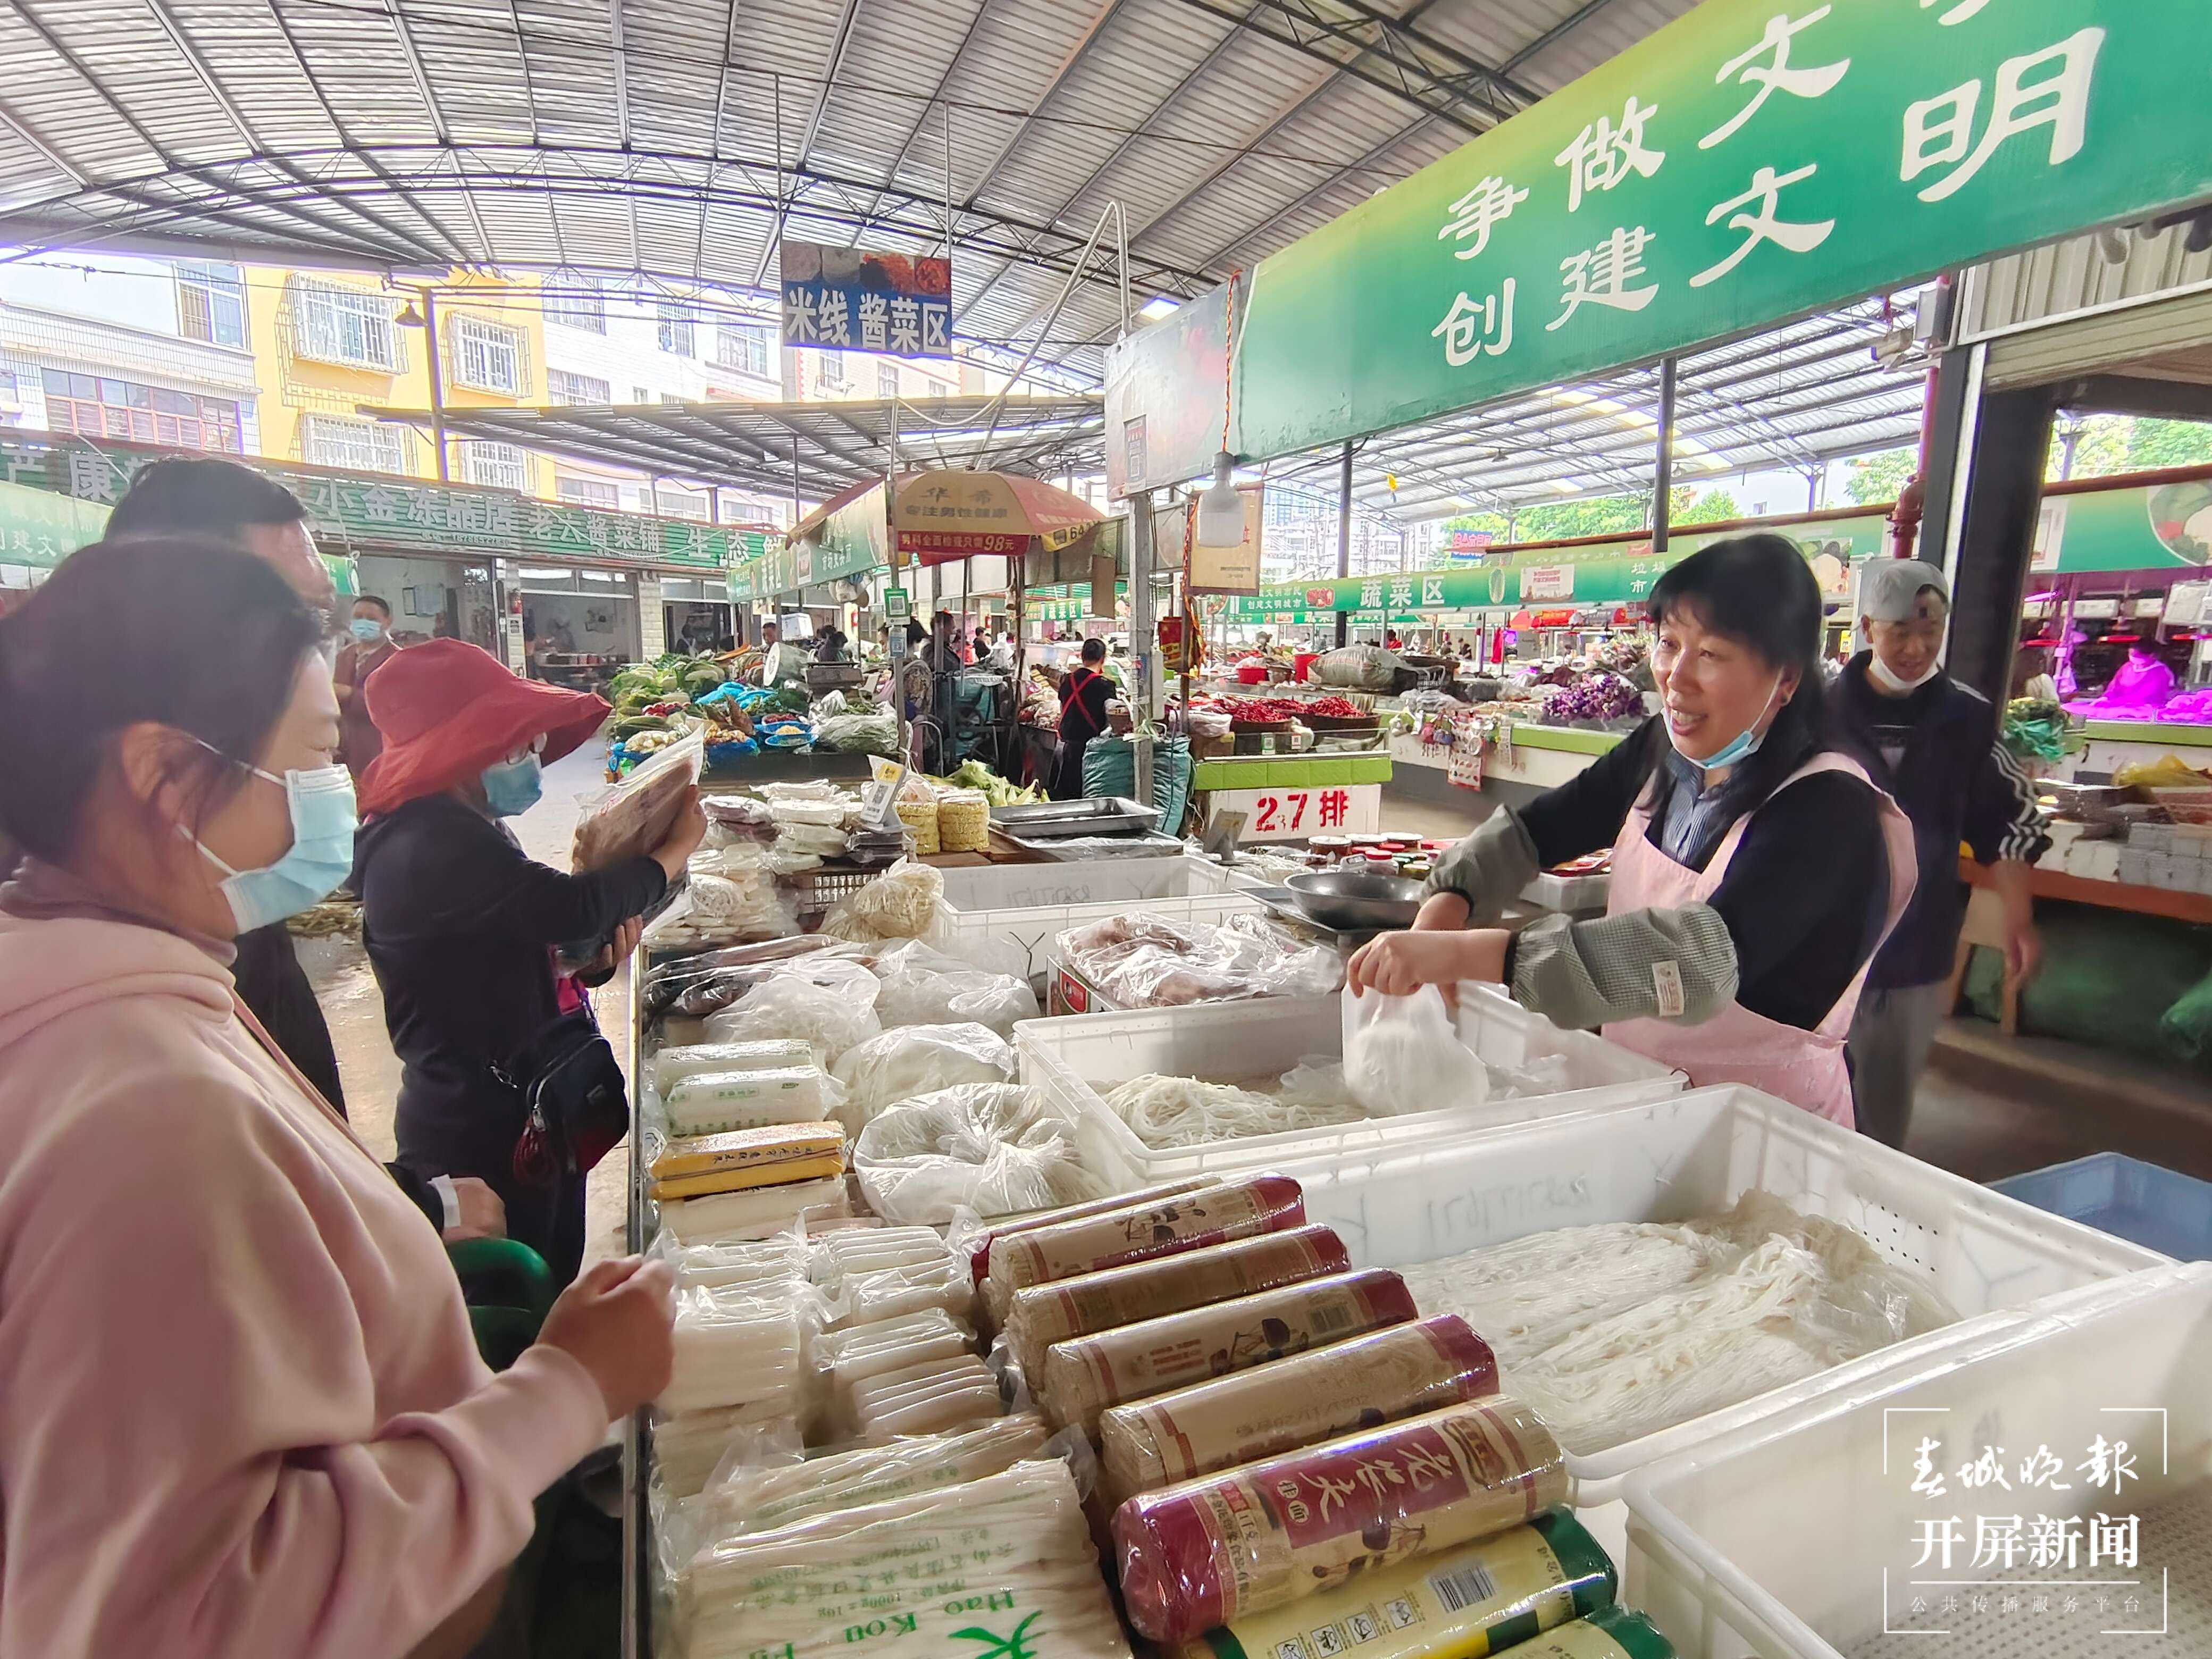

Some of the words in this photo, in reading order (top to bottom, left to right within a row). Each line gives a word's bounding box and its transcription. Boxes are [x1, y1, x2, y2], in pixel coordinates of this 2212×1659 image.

[1438, 0, 1995, 259] 争做文
[1432, 27, 2105, 367] 创建文明
[528, 508, 659, 552] 老六酱菜铺
[1247, 598, 1302, 610] 创建文明城市
[1360, 575, 1445, 608] 蔬菜区
[944, 1592, 1015, 1615] Hao
[844, 1612, 918, 1643] Kou
